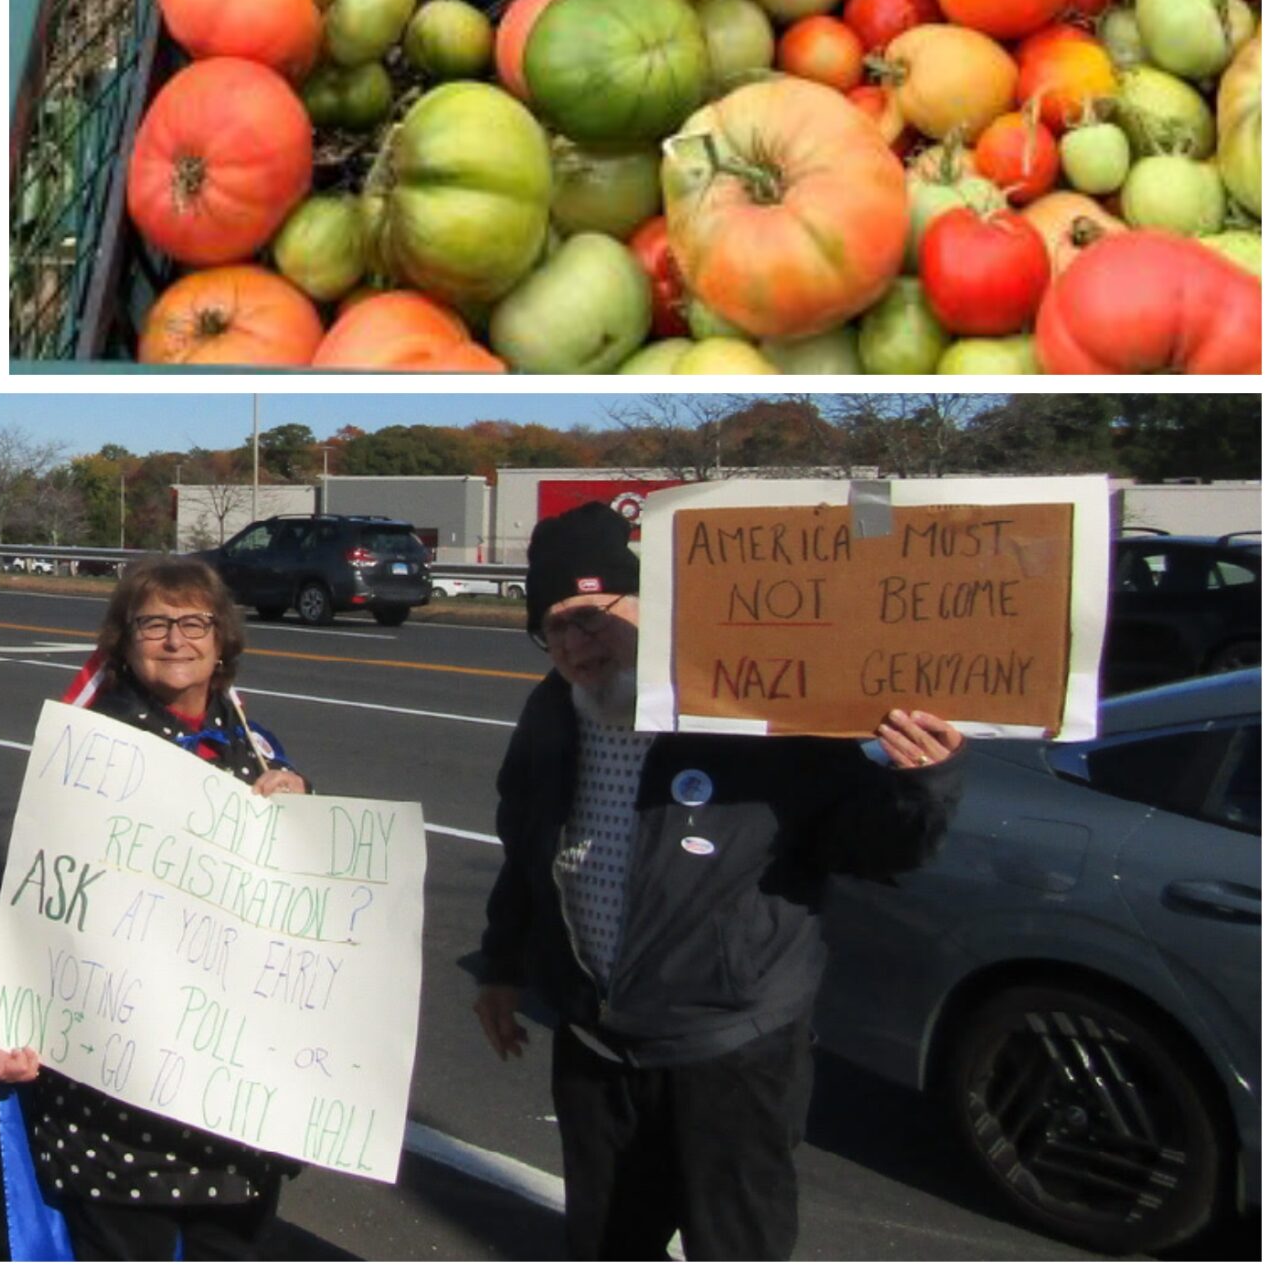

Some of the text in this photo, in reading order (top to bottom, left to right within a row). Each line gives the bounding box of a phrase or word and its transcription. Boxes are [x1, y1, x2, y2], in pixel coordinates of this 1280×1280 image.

[688, 519, 1013, 565] AMERICA MUST
[728, 575, 1021, 624] NOT BECOME
[710, 648, 1034, 699] NAZI GERMANY
[38, 724, 146, 802] NEED
[187, 775, 397, 881] SAME DAY
[10, 848, 344, 1011] ASK AT YOUR EARLY
[48, 946, 144, 1024] VOTING
[176, 985, 245, 1068] POLL
[294, 1046, 333, 1079] OR
[101, 1032, 137, 1092] GO
[150, 1048, 186, 1107] TO
[202, 1066, 279, 1142] CITY
[303, 1095, 377, 1172] HALL
